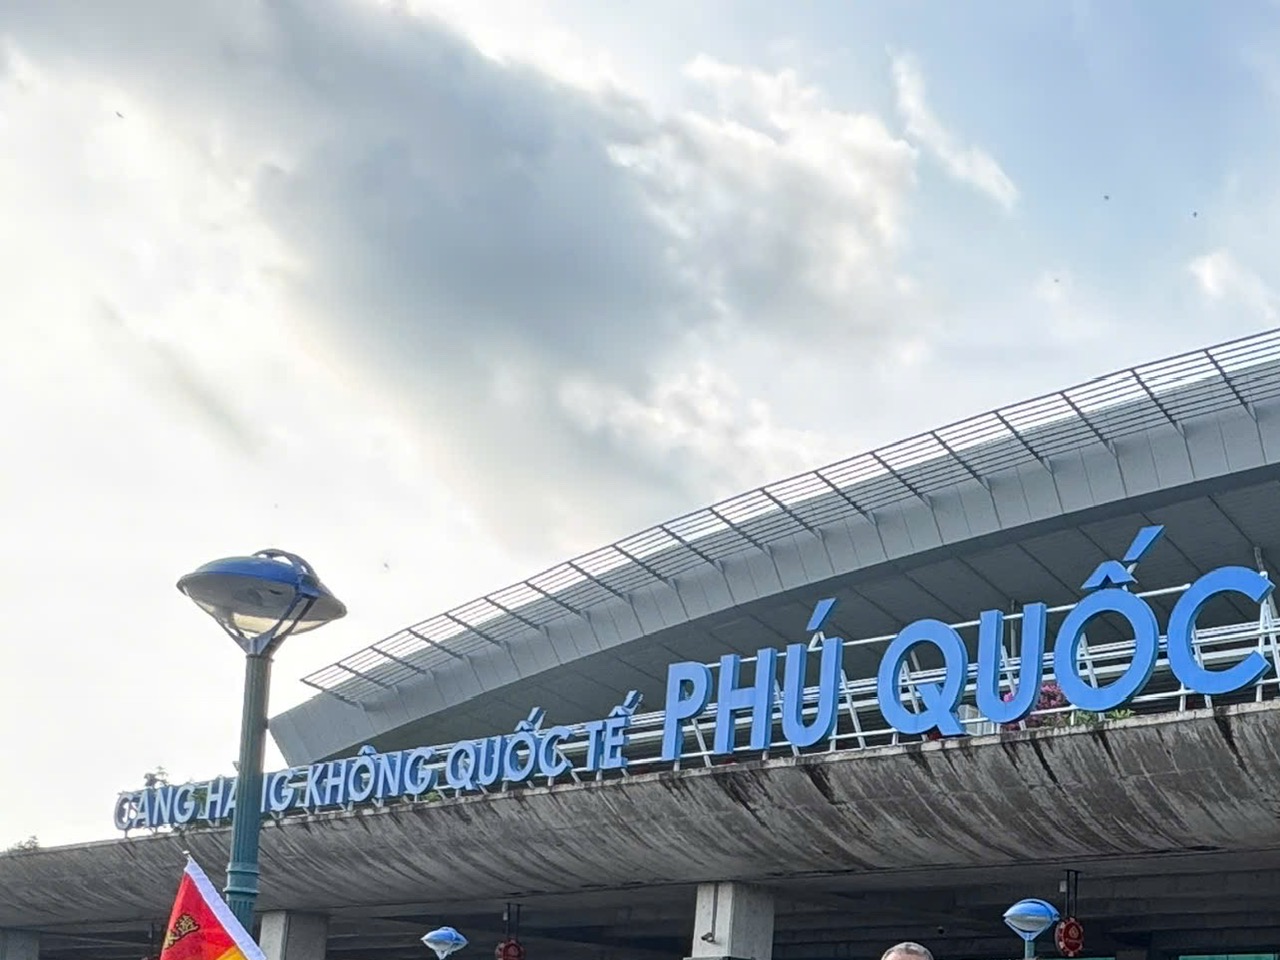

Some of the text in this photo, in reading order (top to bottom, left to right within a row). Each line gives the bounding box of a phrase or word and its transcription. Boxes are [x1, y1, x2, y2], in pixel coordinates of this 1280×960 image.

[661, 525, 1275, 761] PHÚ QUỐC
[304, 745, 436, 807] KHÔNG
[446, 706, 575, 790] QUỐC
[586, 690, 638, 772] TẾ
